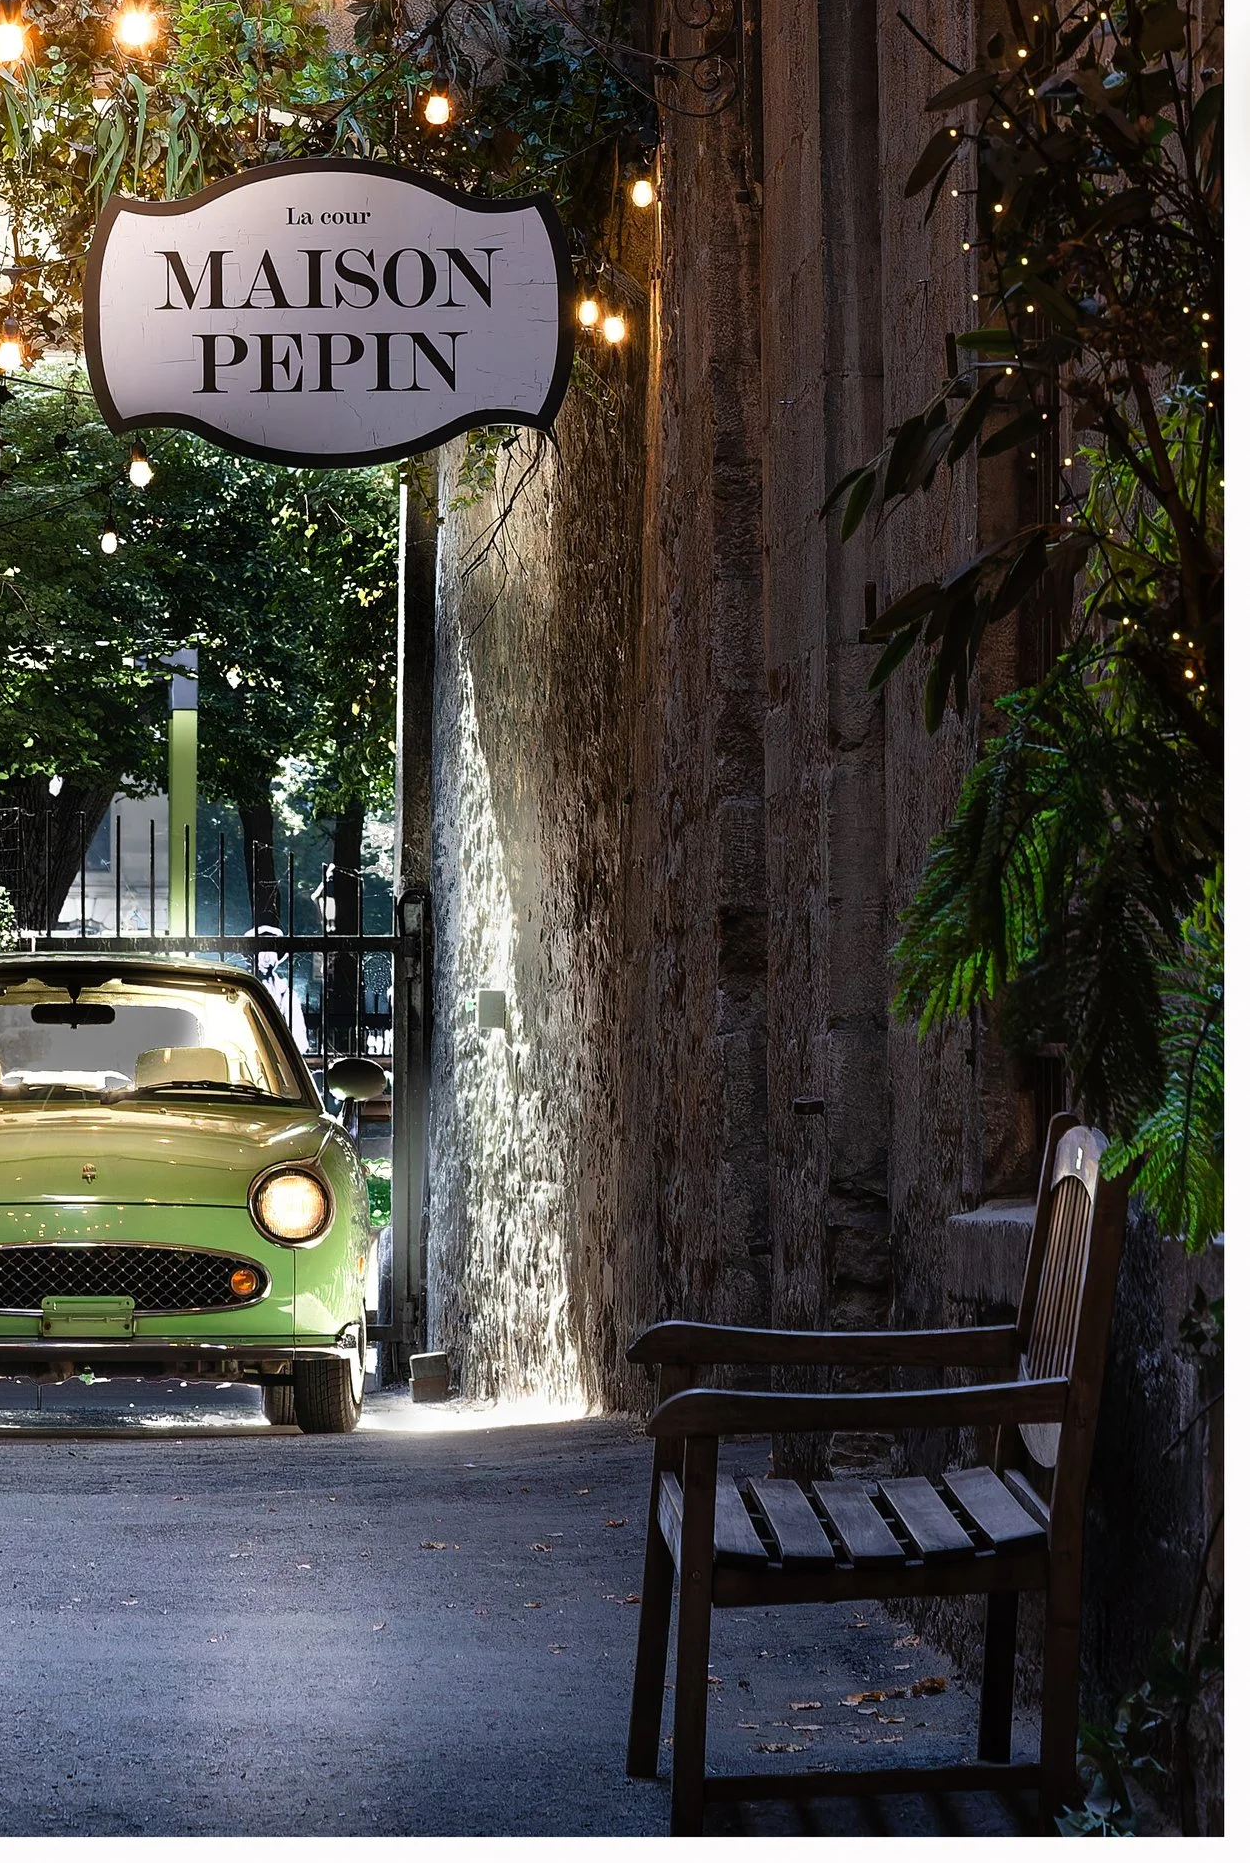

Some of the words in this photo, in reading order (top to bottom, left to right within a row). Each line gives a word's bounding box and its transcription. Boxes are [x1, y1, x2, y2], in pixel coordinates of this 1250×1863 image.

[285, 207, 314, 225] La
[319, 210, 372, 225] cour
[154, 247, 504, 310] MAISON
[192, 331, 468, 394] PEPIN
